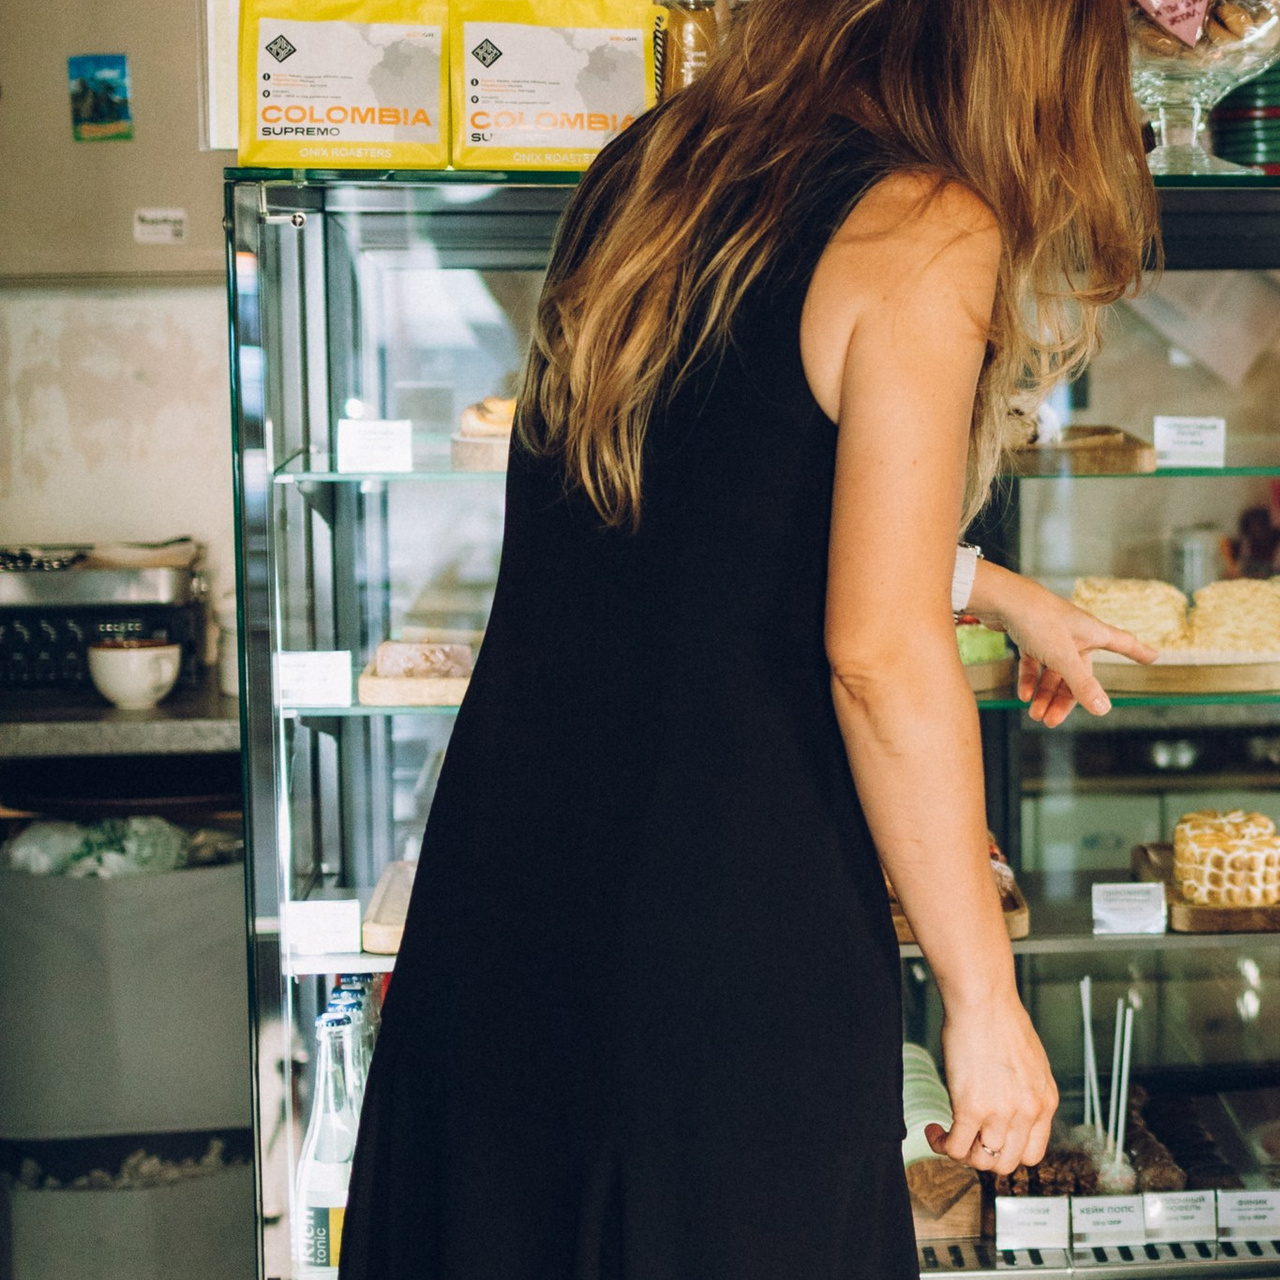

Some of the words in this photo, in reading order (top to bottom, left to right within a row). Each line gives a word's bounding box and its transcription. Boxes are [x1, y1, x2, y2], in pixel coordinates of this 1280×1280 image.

[261, 104, 432, 127] COLOMBIA
[262, 127, 340, 137] SUPREMO
[300, 147, 329, 158] ONIX
[331, 148, 392, 159] ROASTERS
[513, 152, 542, 163] ONIX
[1080, 1205, 1105, 1215] КЕЙК
[1107, 1205, 1135, 1214] ПОПС
[316, 1227, 326, 1264] tonic
